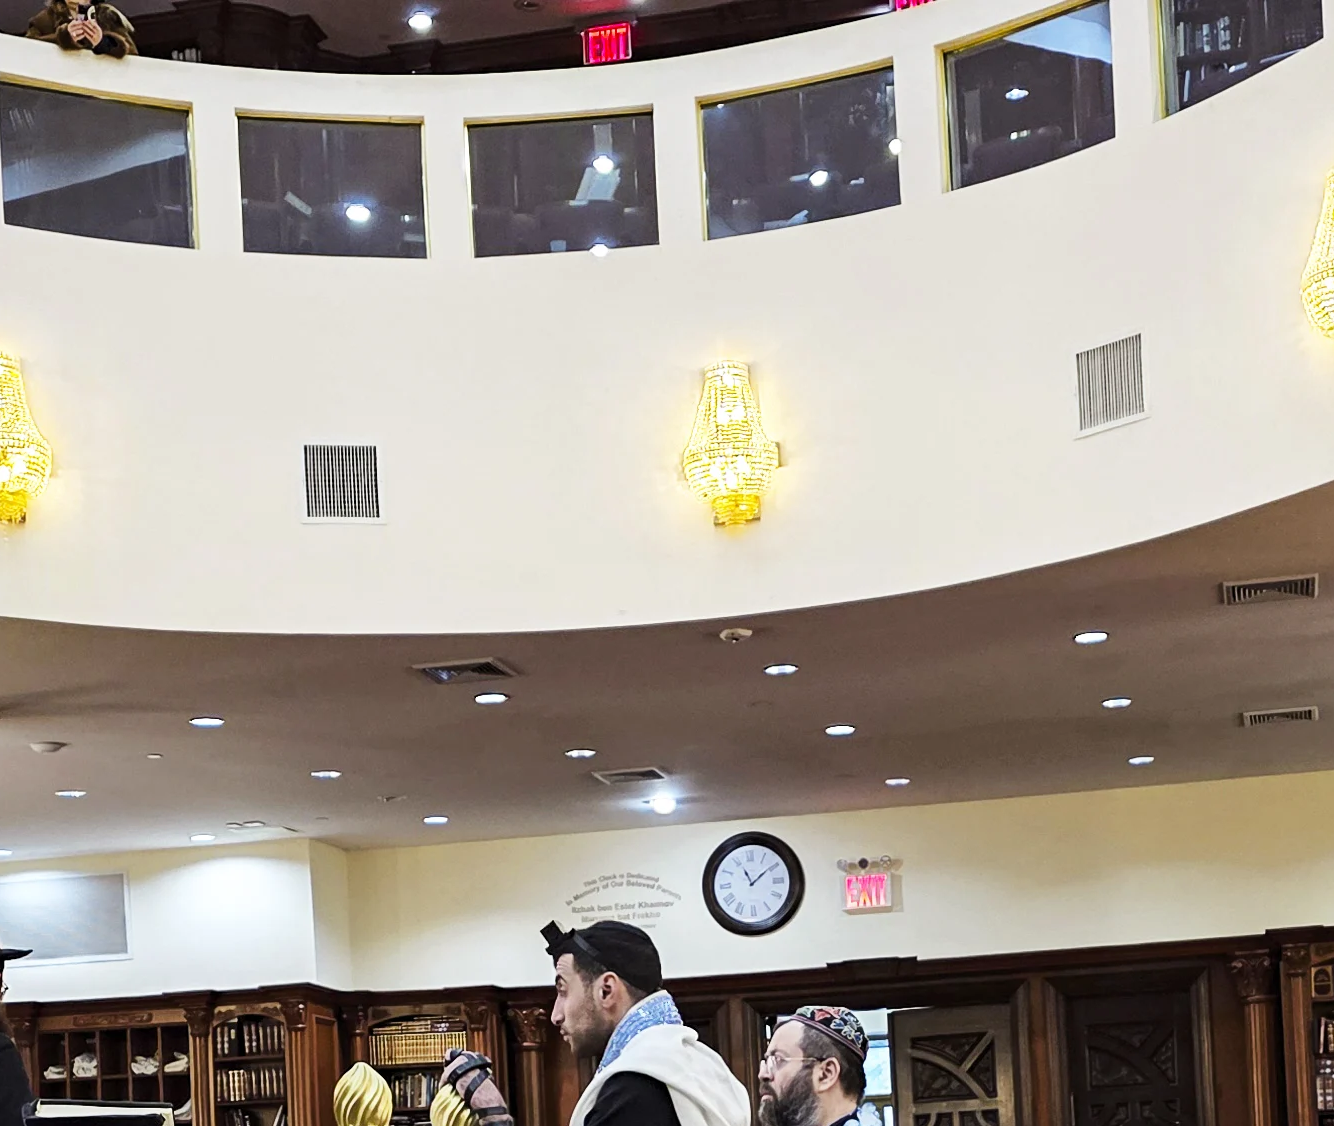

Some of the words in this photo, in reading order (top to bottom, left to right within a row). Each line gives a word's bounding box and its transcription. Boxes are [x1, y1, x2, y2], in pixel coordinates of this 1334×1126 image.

[588, 27, 627, 63] EXIT
[610, 880, 624, 888] Our
[626, 879, 655, 890] Beloved
[845, 874, 887, 909] EXIT
